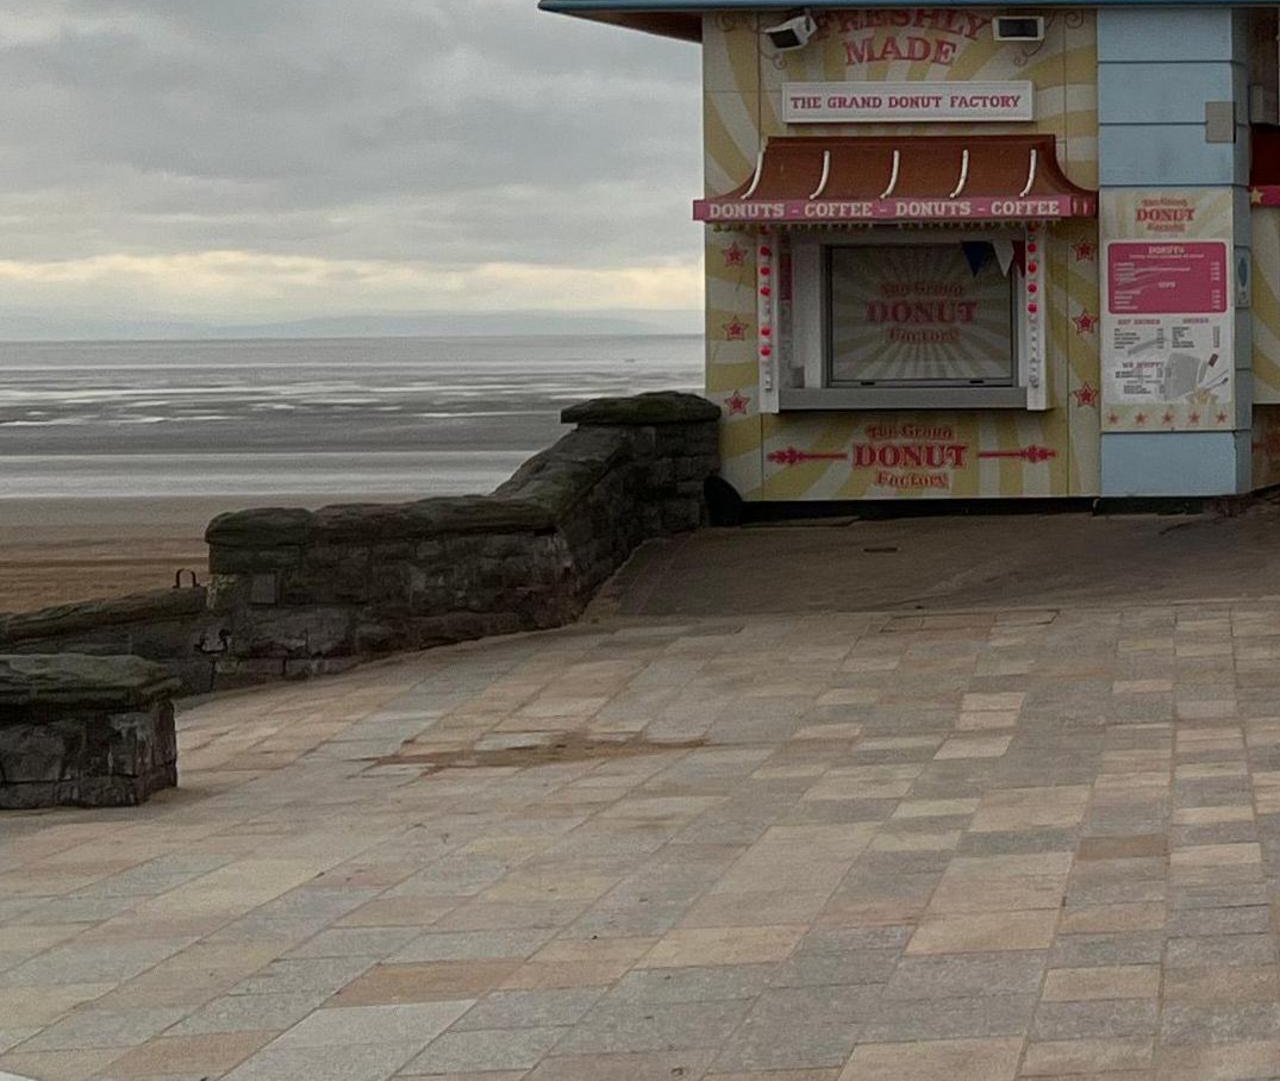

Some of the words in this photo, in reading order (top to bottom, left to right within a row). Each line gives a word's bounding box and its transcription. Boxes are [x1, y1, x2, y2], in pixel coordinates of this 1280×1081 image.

[844, 36, 957, 66] MADE
[790, 96, 822, 109] THE
[827, 96, 883, 108] GRAND
[888, 96, 942, 108] DONUT
[949, 95, 1021, 108] FACTORY
[709, 202, 785, 217] DONUTS
[804, 202, 873, 217] COFFEE
[895, 201, 971, 217] DONUTS
[990, 201, 1060, 216] COFFEE
[1136, 208, 1196, 221] DONUT
[864, 301, 977, 322] DONUT
[855, 445, 969, 467] DONUT
